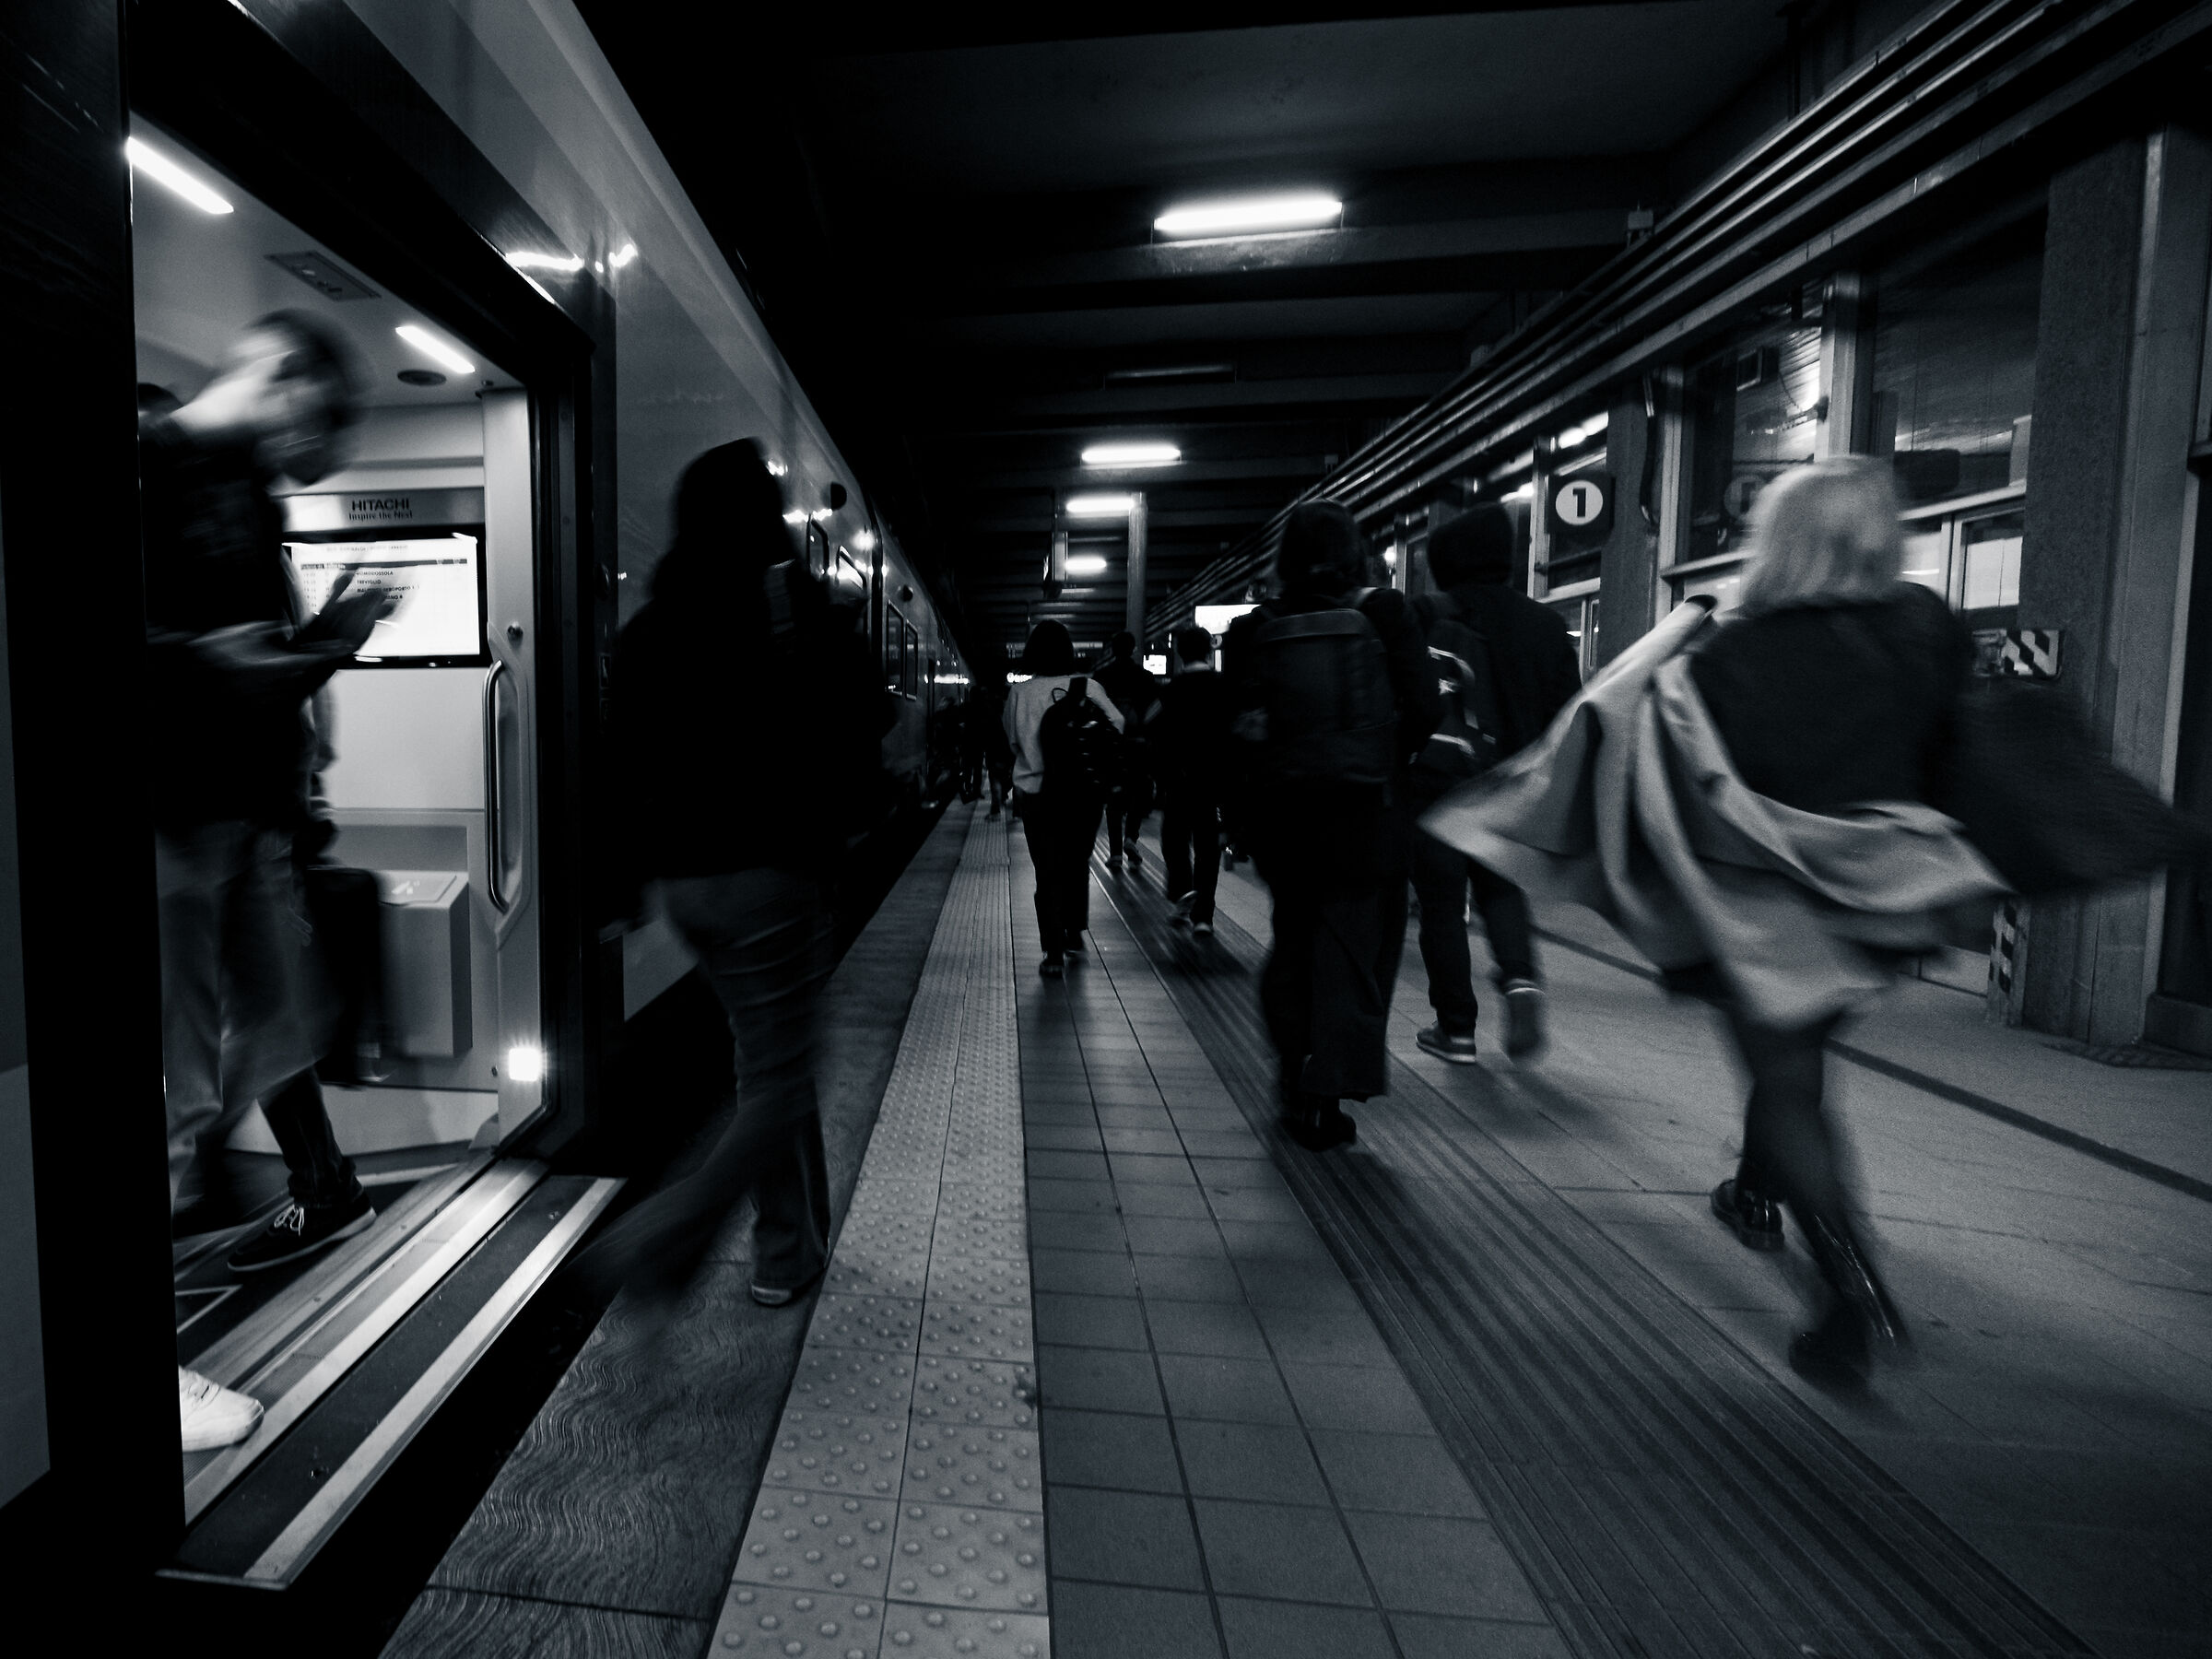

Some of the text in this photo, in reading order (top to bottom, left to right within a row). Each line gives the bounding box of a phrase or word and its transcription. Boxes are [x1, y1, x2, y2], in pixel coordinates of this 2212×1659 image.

[352, 498, 409, 512] HITACHI
[1572, 488, 1586, 517] 1
[349, 509, 413, 522] Inspire the Next
